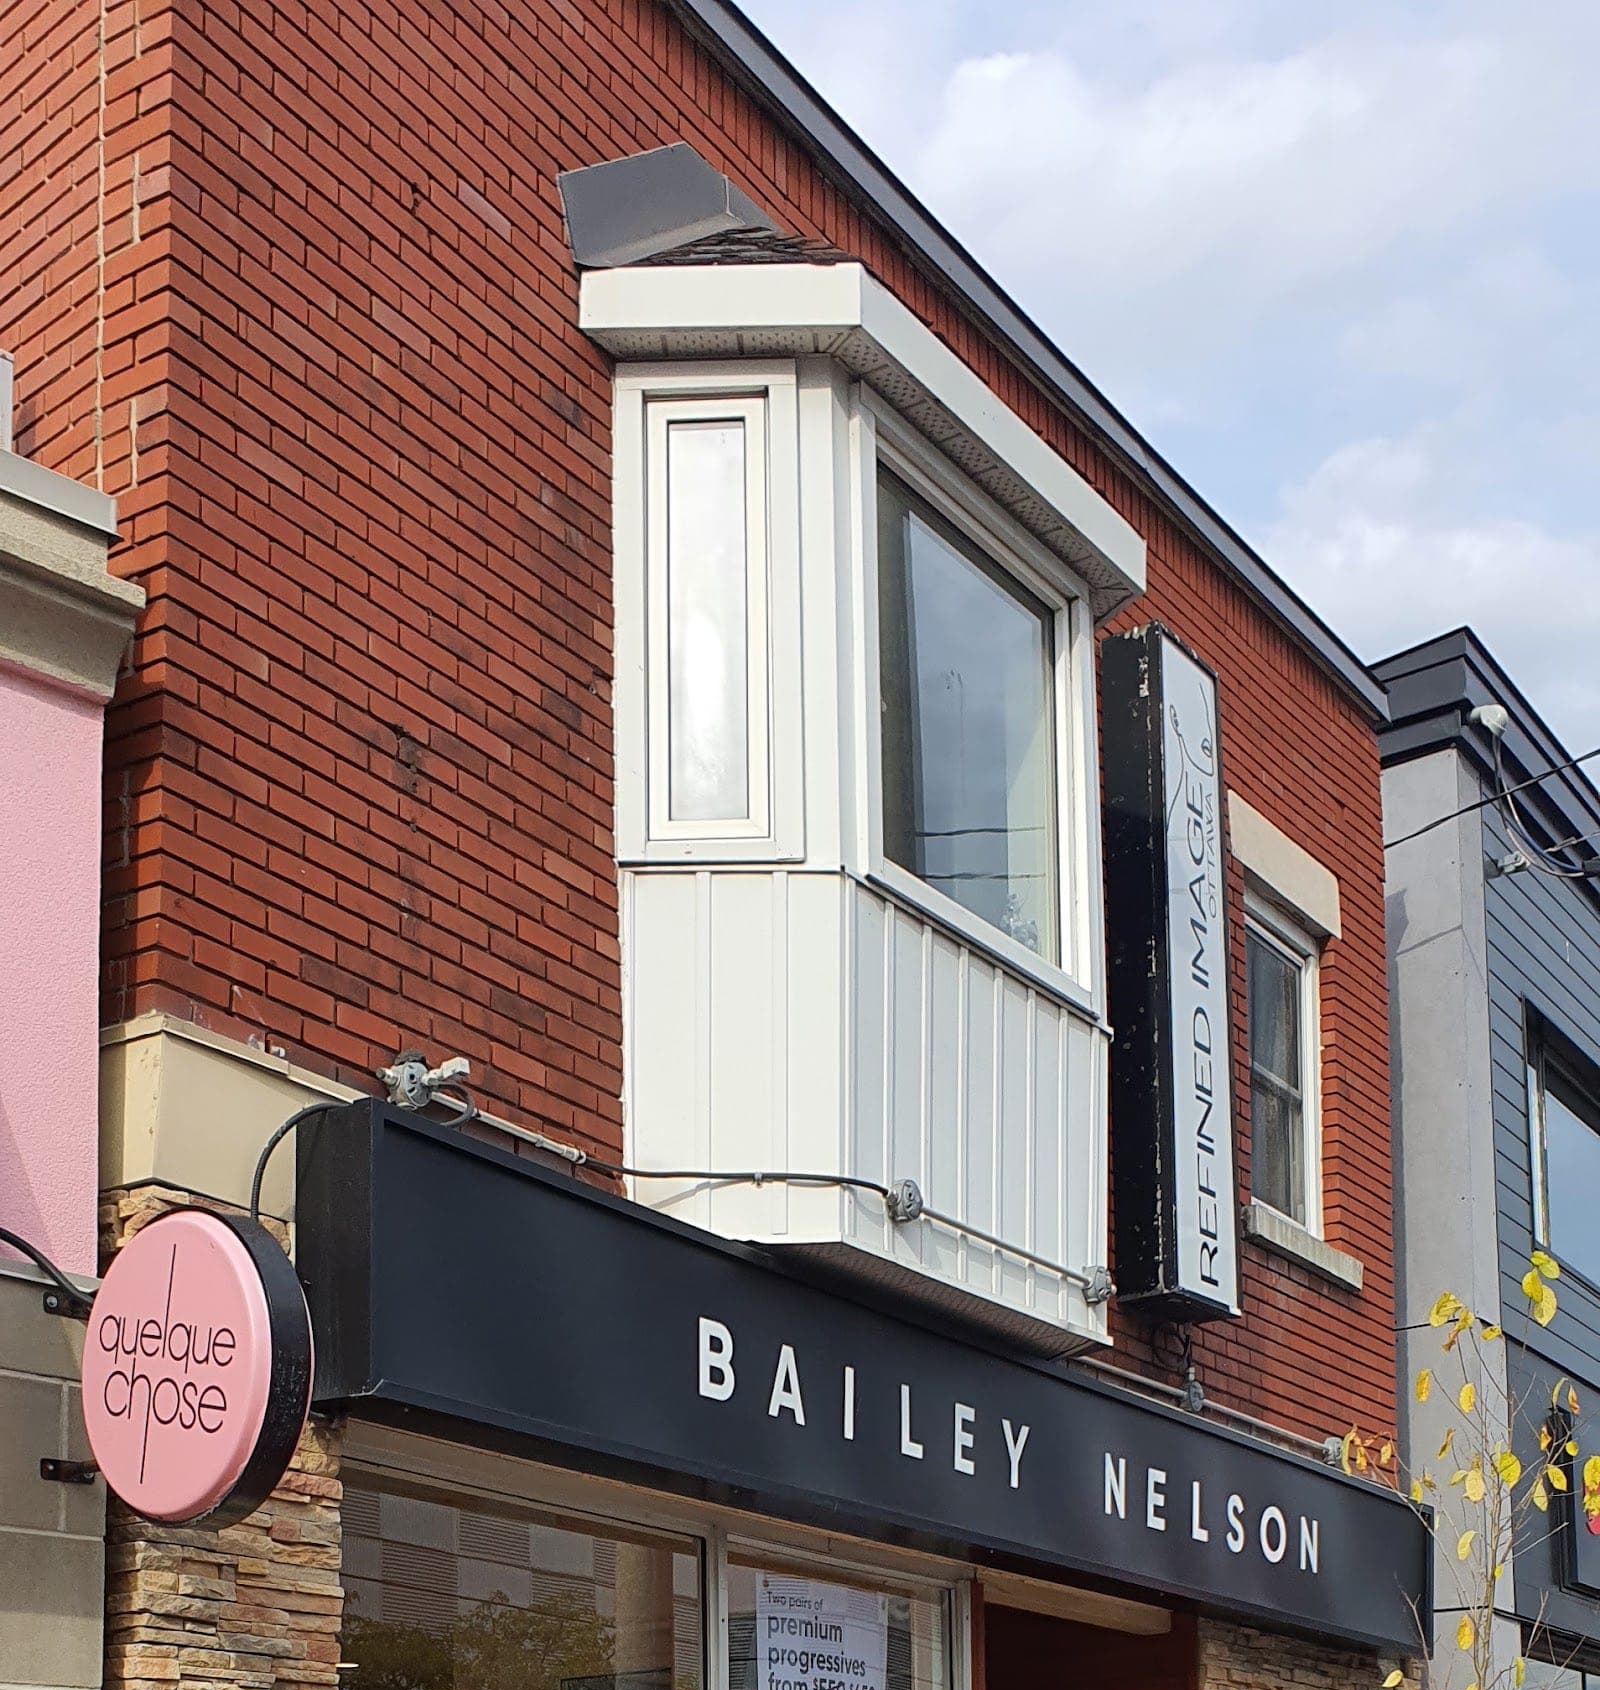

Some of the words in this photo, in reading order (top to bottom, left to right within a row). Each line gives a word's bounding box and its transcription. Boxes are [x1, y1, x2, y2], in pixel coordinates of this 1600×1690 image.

[1186, 771, 1210, 989] IMAGE
[1203, 793, 1217, 919] OTTAWA
[1193, 1006, 1220, 1288] REFINED
[99, 1243, 237, 1374] quelque
[103, 1357, 228, 1485] chose
[698, 1316, 1031, 1489] BAILEY
[1104, 1451, 1320, 1574] NELSON
[767, 1591, 786, 1606] Two
[788, 1597, 812, 1609] pairs
[814, 1599, 824, 1610] of
[767, 1616, 843, 1643] premium
[768, 1647, 866, 1677] progressives
